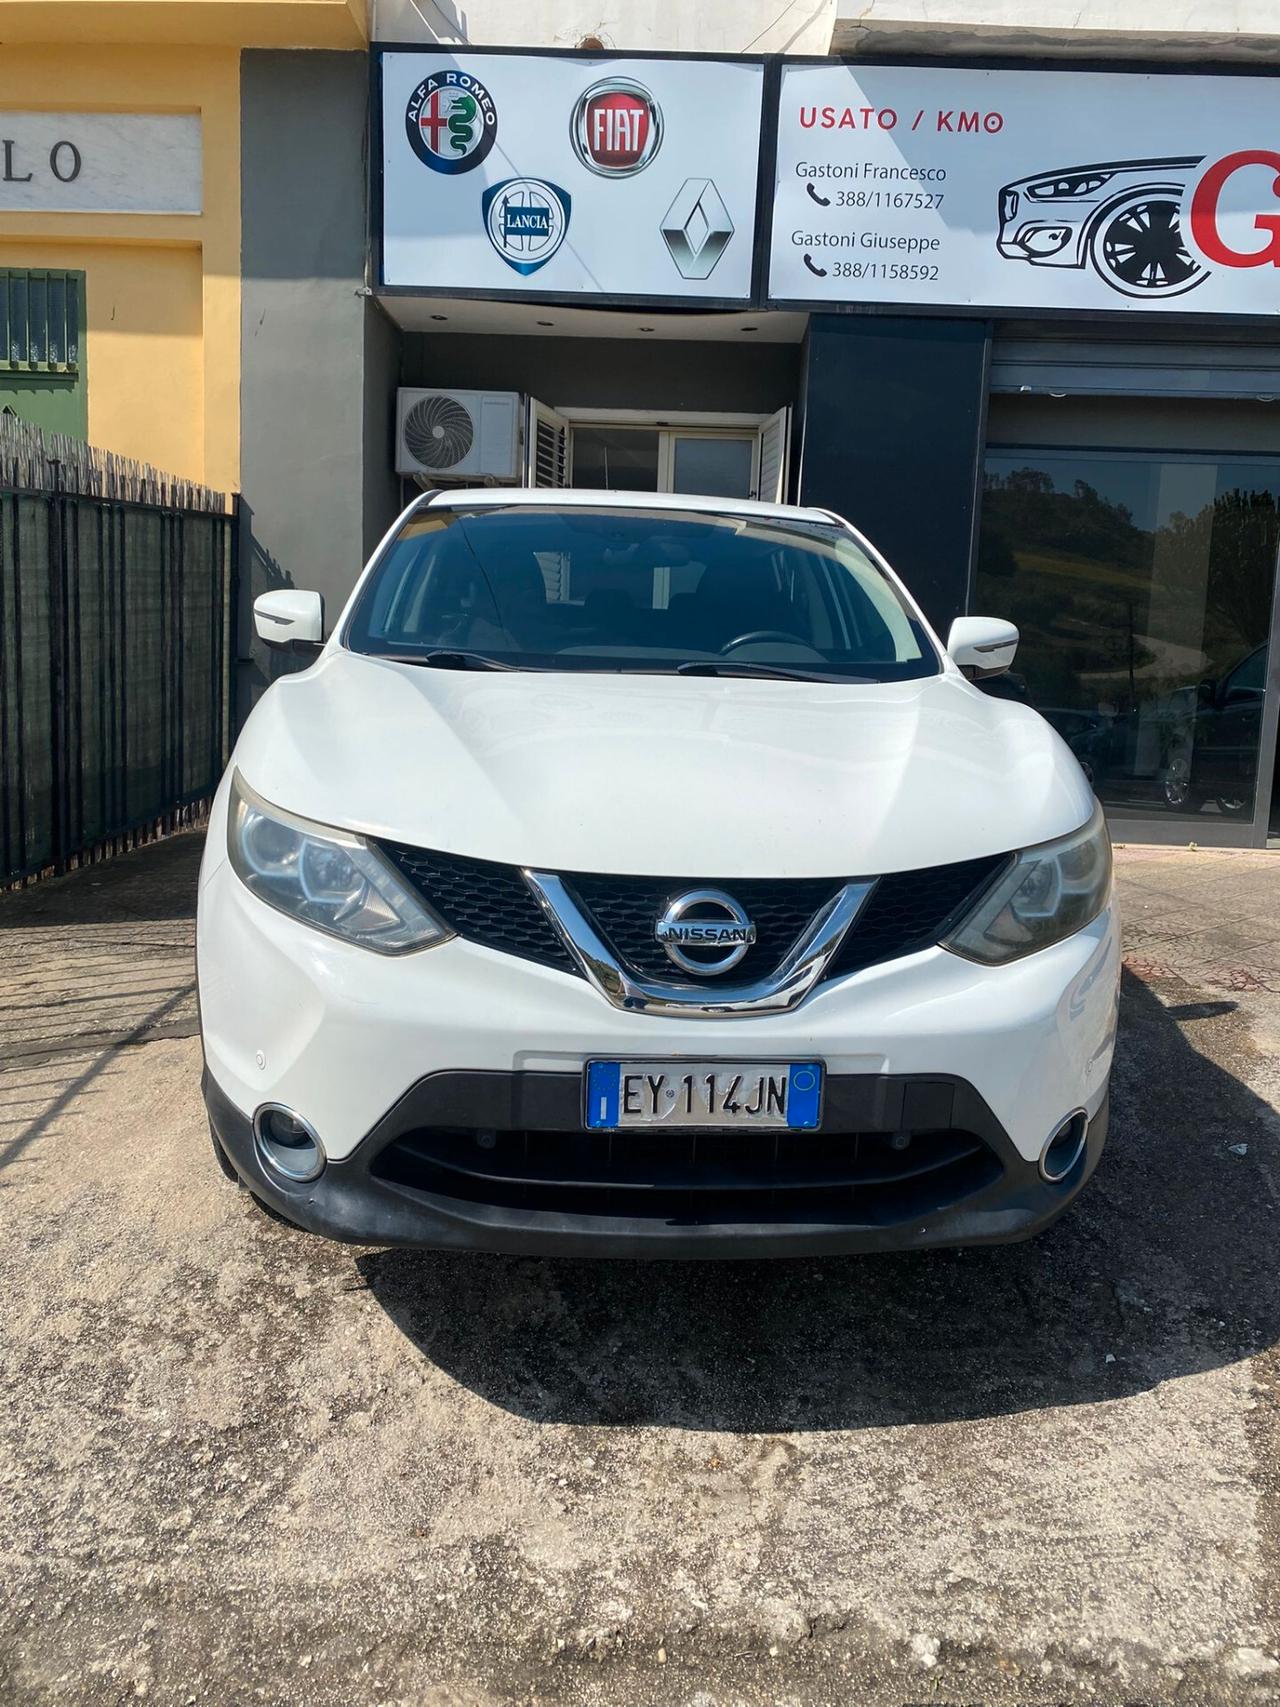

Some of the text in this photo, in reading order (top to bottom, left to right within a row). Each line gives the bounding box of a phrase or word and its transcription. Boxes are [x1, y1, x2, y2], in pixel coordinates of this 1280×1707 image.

[408, 73, 495, 125] ALFA ROMEO
[799, 106, 898, 130] USATO
[911, 109, 925, 131] /
[594, 109, 644, 151] FIAT
[795, 161, 947, 182] Gastoni Francesco
[835, 191, 945, 210] 388/1167527
[507, 214, 548, 229] LANCIA
[791, 230, 940, 254] Gastoni Giuseppe
[832, 262, 939, 281] 388/1158592
[667, 927, 747, 941] NISSAN
